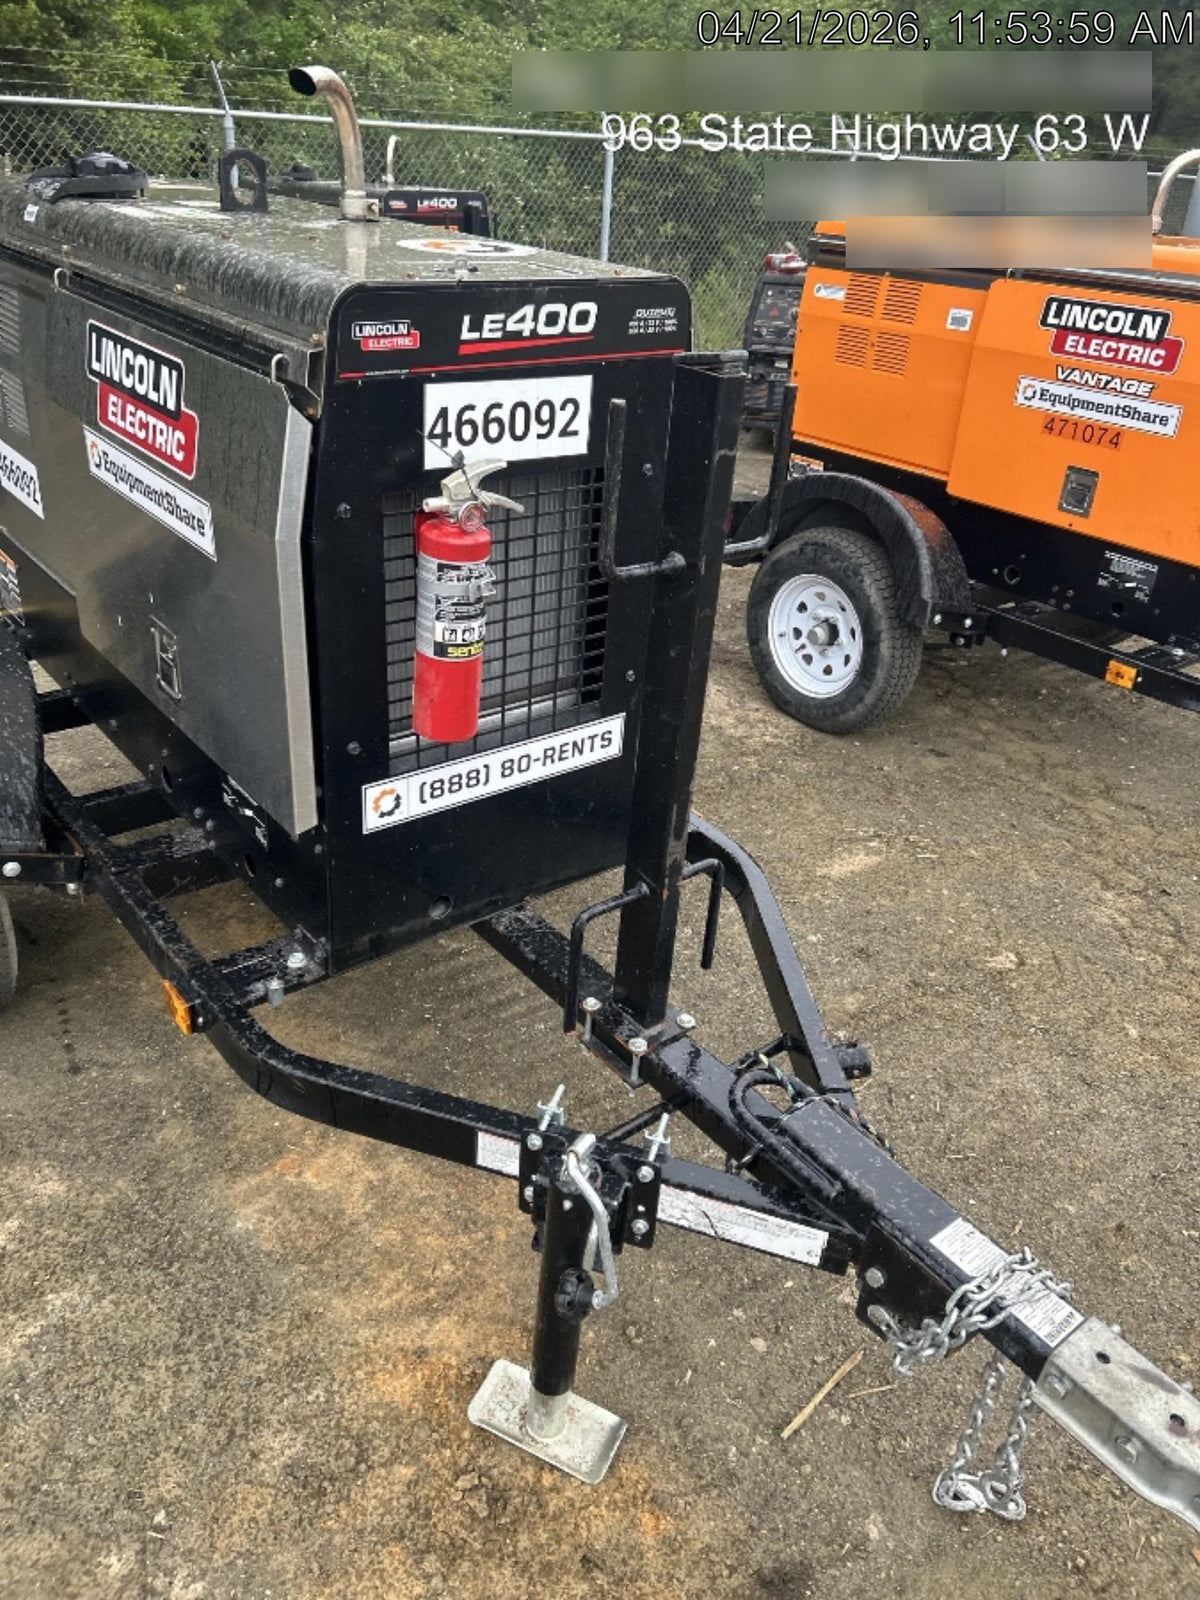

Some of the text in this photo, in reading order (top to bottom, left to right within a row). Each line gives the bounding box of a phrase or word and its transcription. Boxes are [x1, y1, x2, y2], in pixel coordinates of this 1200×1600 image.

[355, 323, 408, 337] LINCOLN
[460, 301, 598, 340] LE400
[1046, 301, 1164, 340] LINCOLN
[368, 337, 414, 348] ELECTRIC
[1063, 334, 1167, 367] ELECTRIC
[91, 332, 178, 411] LINCOLN
[1056, 365, 1156, 398] VANTAGE
[427, 397, 580, 448] 466092
[1037, 387, 1171, 427] EquipmentShare
[107, 393, 186, 462] ELECTRIC
[1044, 417, 1122, 449] 471074
[101, 449, 206, 538] EquipmentShare
[418, 730, 613, 804] (888) 80-RENTS
